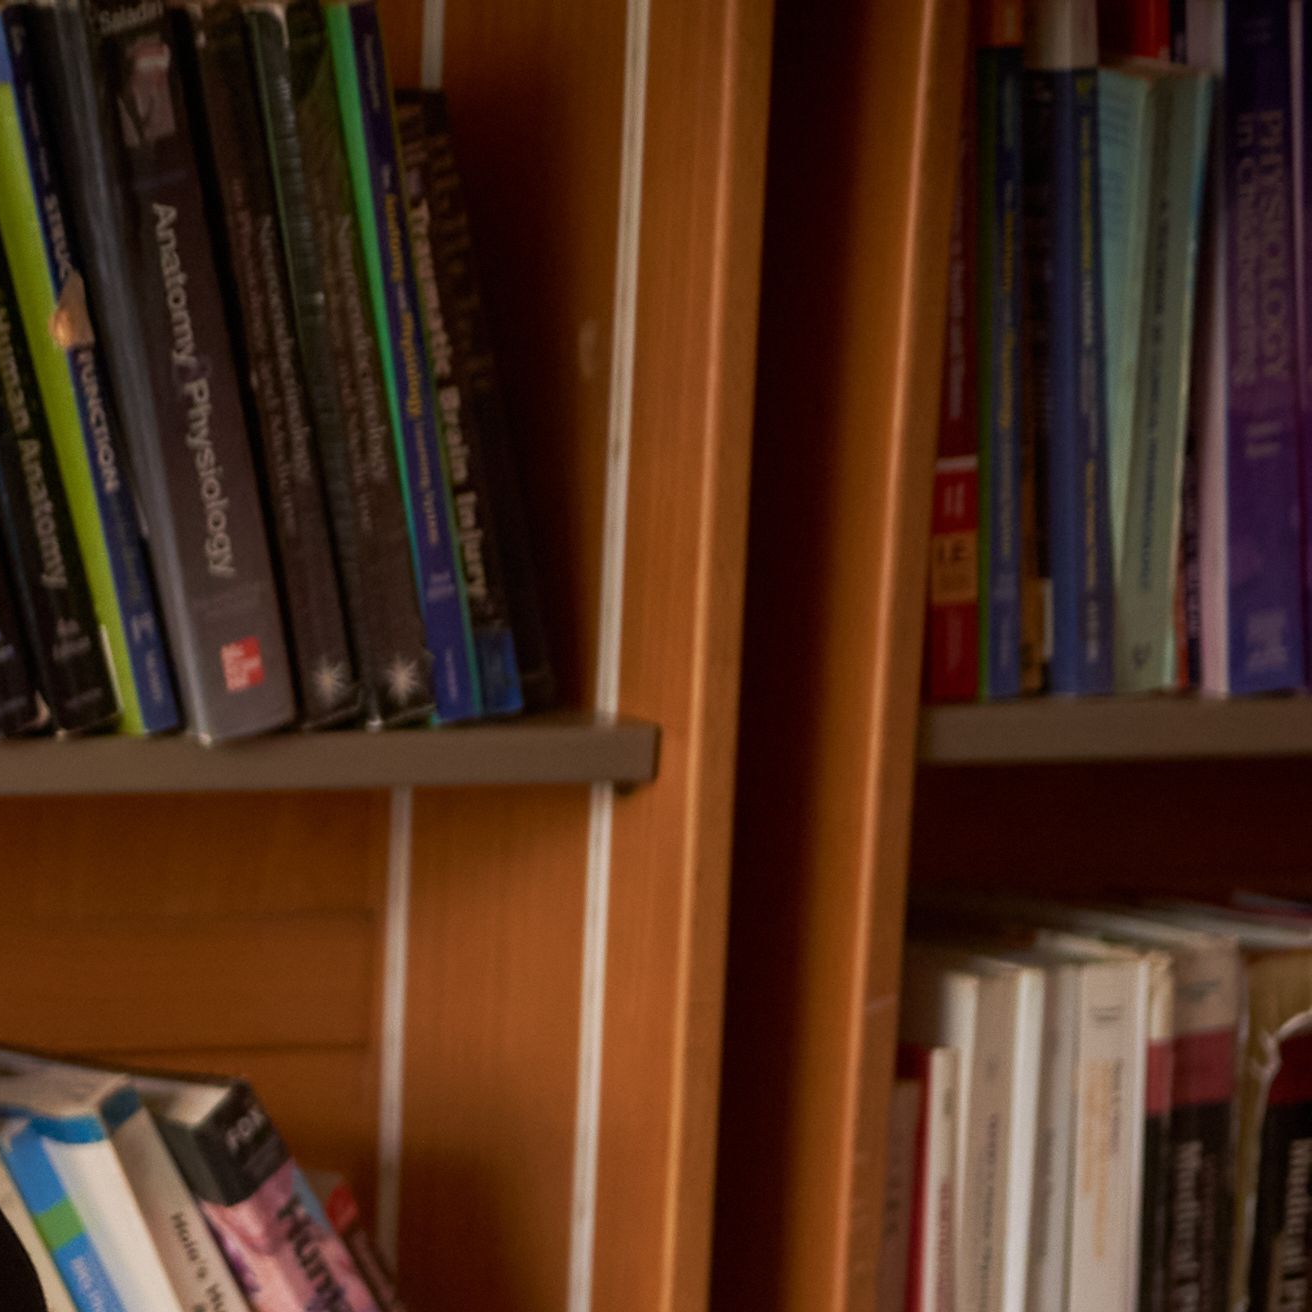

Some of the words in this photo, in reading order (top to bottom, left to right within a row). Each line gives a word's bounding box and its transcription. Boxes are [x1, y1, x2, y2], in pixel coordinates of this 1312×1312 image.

[1257, 109, 1288, 380] PHYSIOLOGY
[73, 349, 120, 494] FUNCTION
[151, 201, 199, 369] Anatomy
[183, 377, 236, 578] Physiology
[438, 384, 469, 485] Brain
[16, 438, 68, 589] Anatomy
[226, 1105, 266, 1151] FOX
